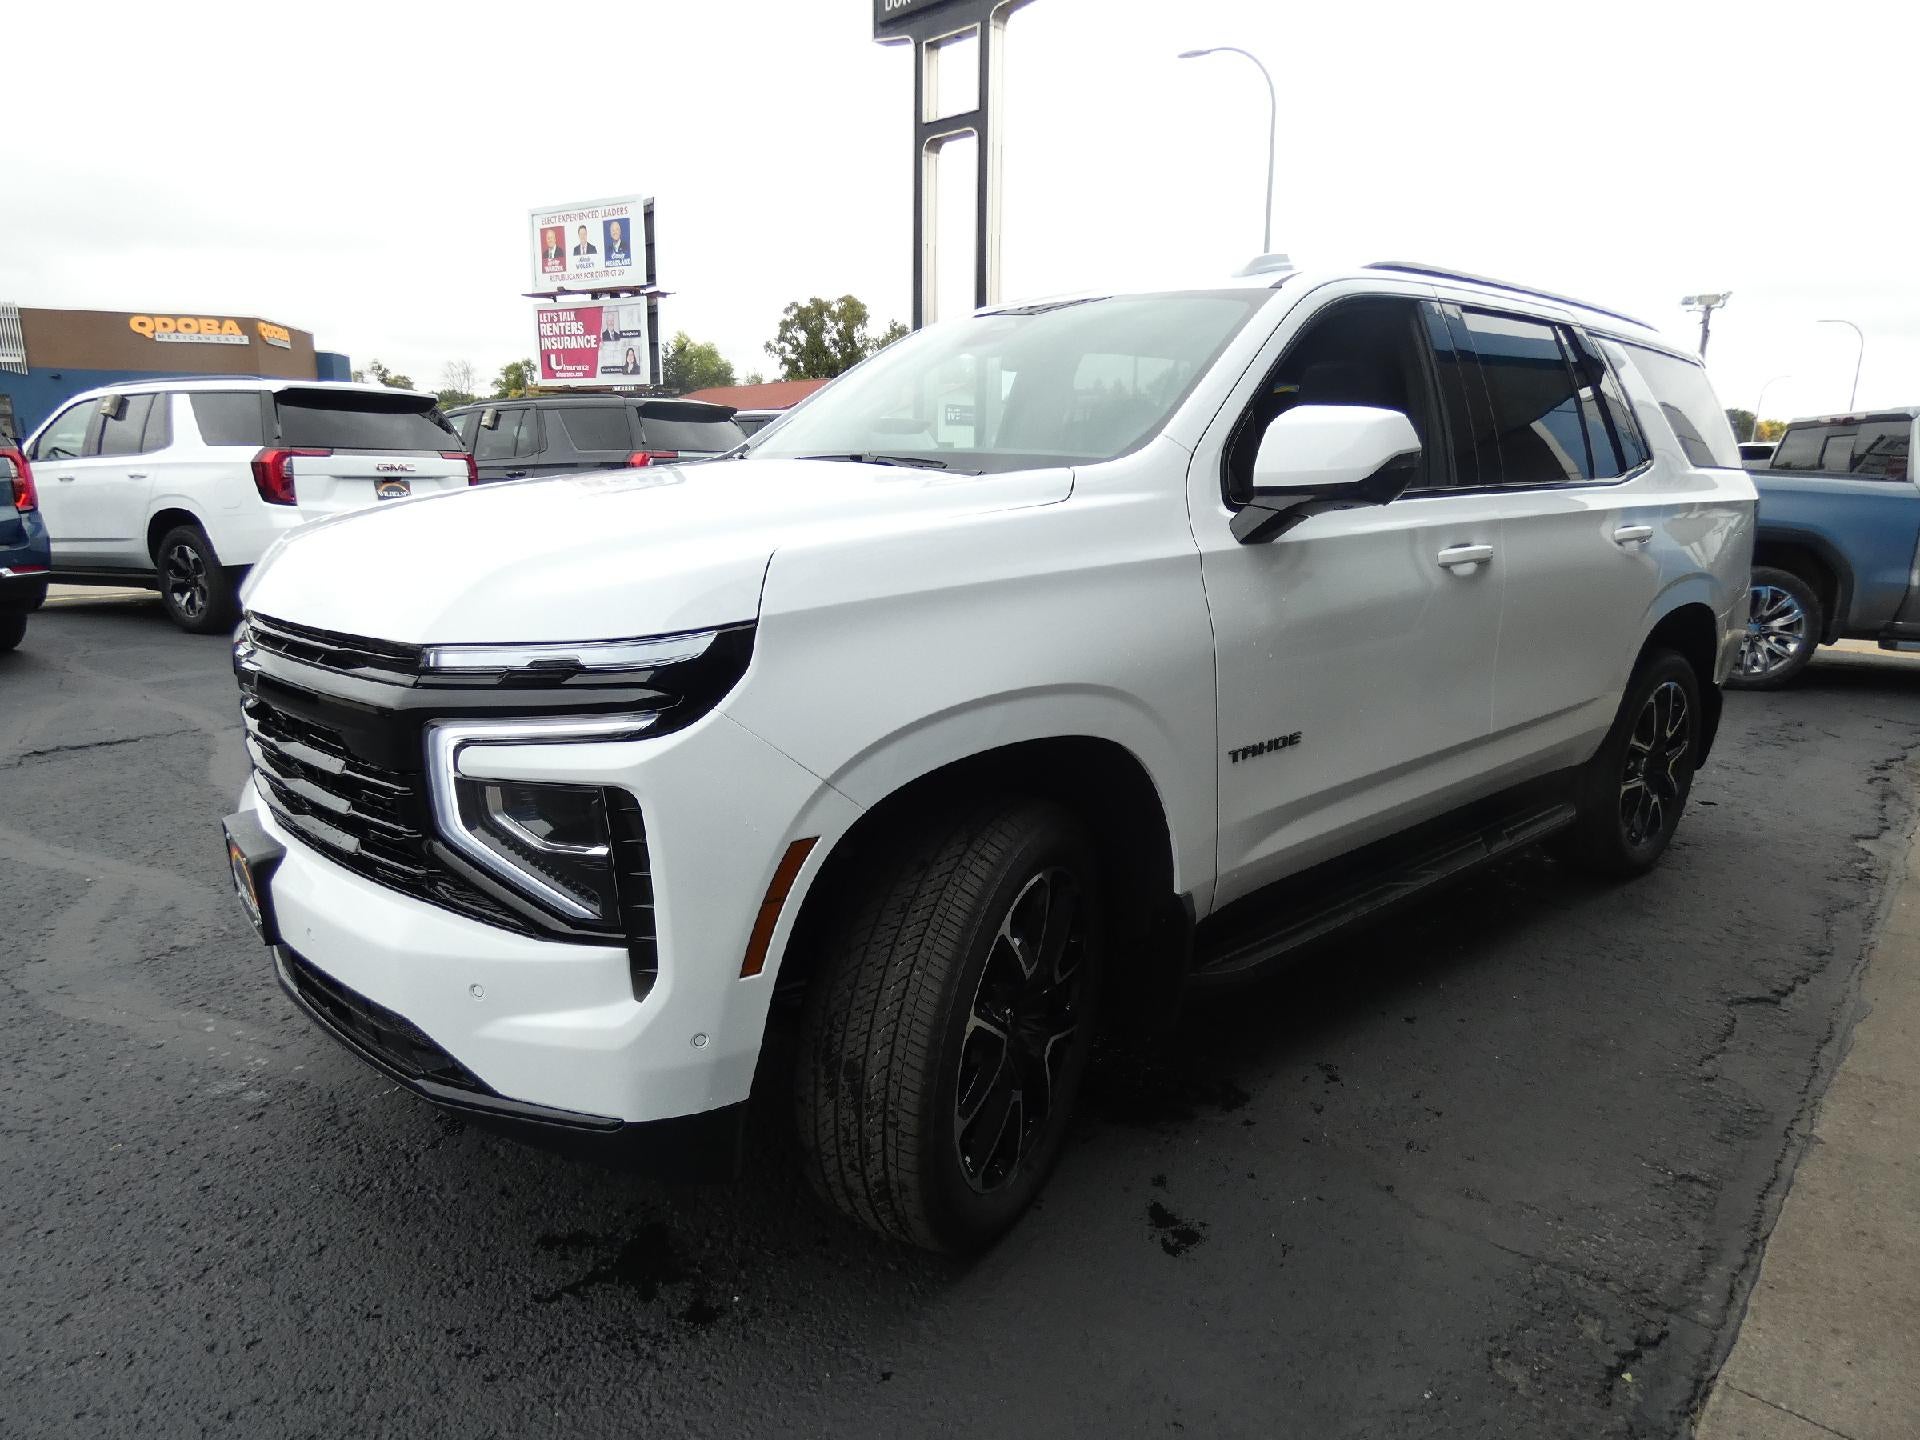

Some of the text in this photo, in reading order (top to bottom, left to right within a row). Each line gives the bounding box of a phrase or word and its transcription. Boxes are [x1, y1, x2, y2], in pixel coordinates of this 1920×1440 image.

[541, 206, 628, 226] ELECT EXPERIENCED LEADERS
[549, 272, 583, 283] REPUBLICANS
[583, 270, 595, 279] FOR
[594, 269, 617, 278] DISTRICT
[539, 311, 576, 323] LET'S TALK
[129, 315, 243, 339] QDOBA
[540, 321, 584, 336] RENTERS
[157, 333, 211, 342] MEXICAN
[541, 335, 598, 350] INSURANCE
[376, 463, 416, 472] GMC
[1228, 730, 1303, 763] TAHOE
